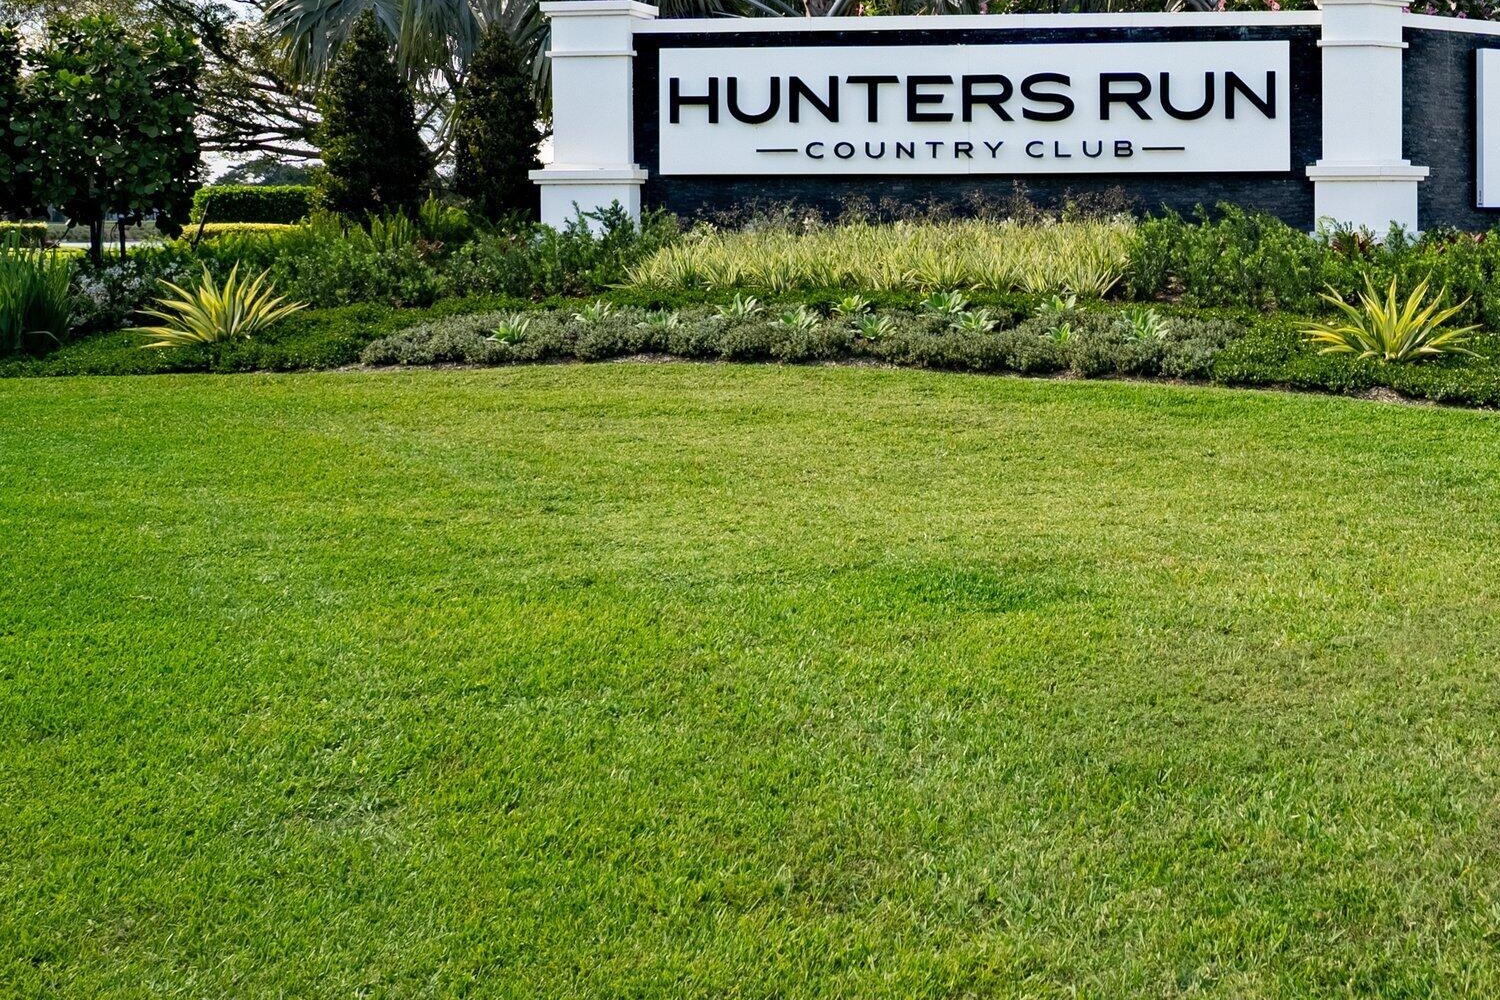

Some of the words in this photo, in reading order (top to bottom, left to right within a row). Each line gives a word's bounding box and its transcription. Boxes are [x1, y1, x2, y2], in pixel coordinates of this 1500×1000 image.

[669, 72, 1075, 125] HUNTERS
[1099, 70, 1277, 121] RUN
[805, 141, 1004, 160] COUNTRY
[1025, 140, 1134, 159] CLUB
